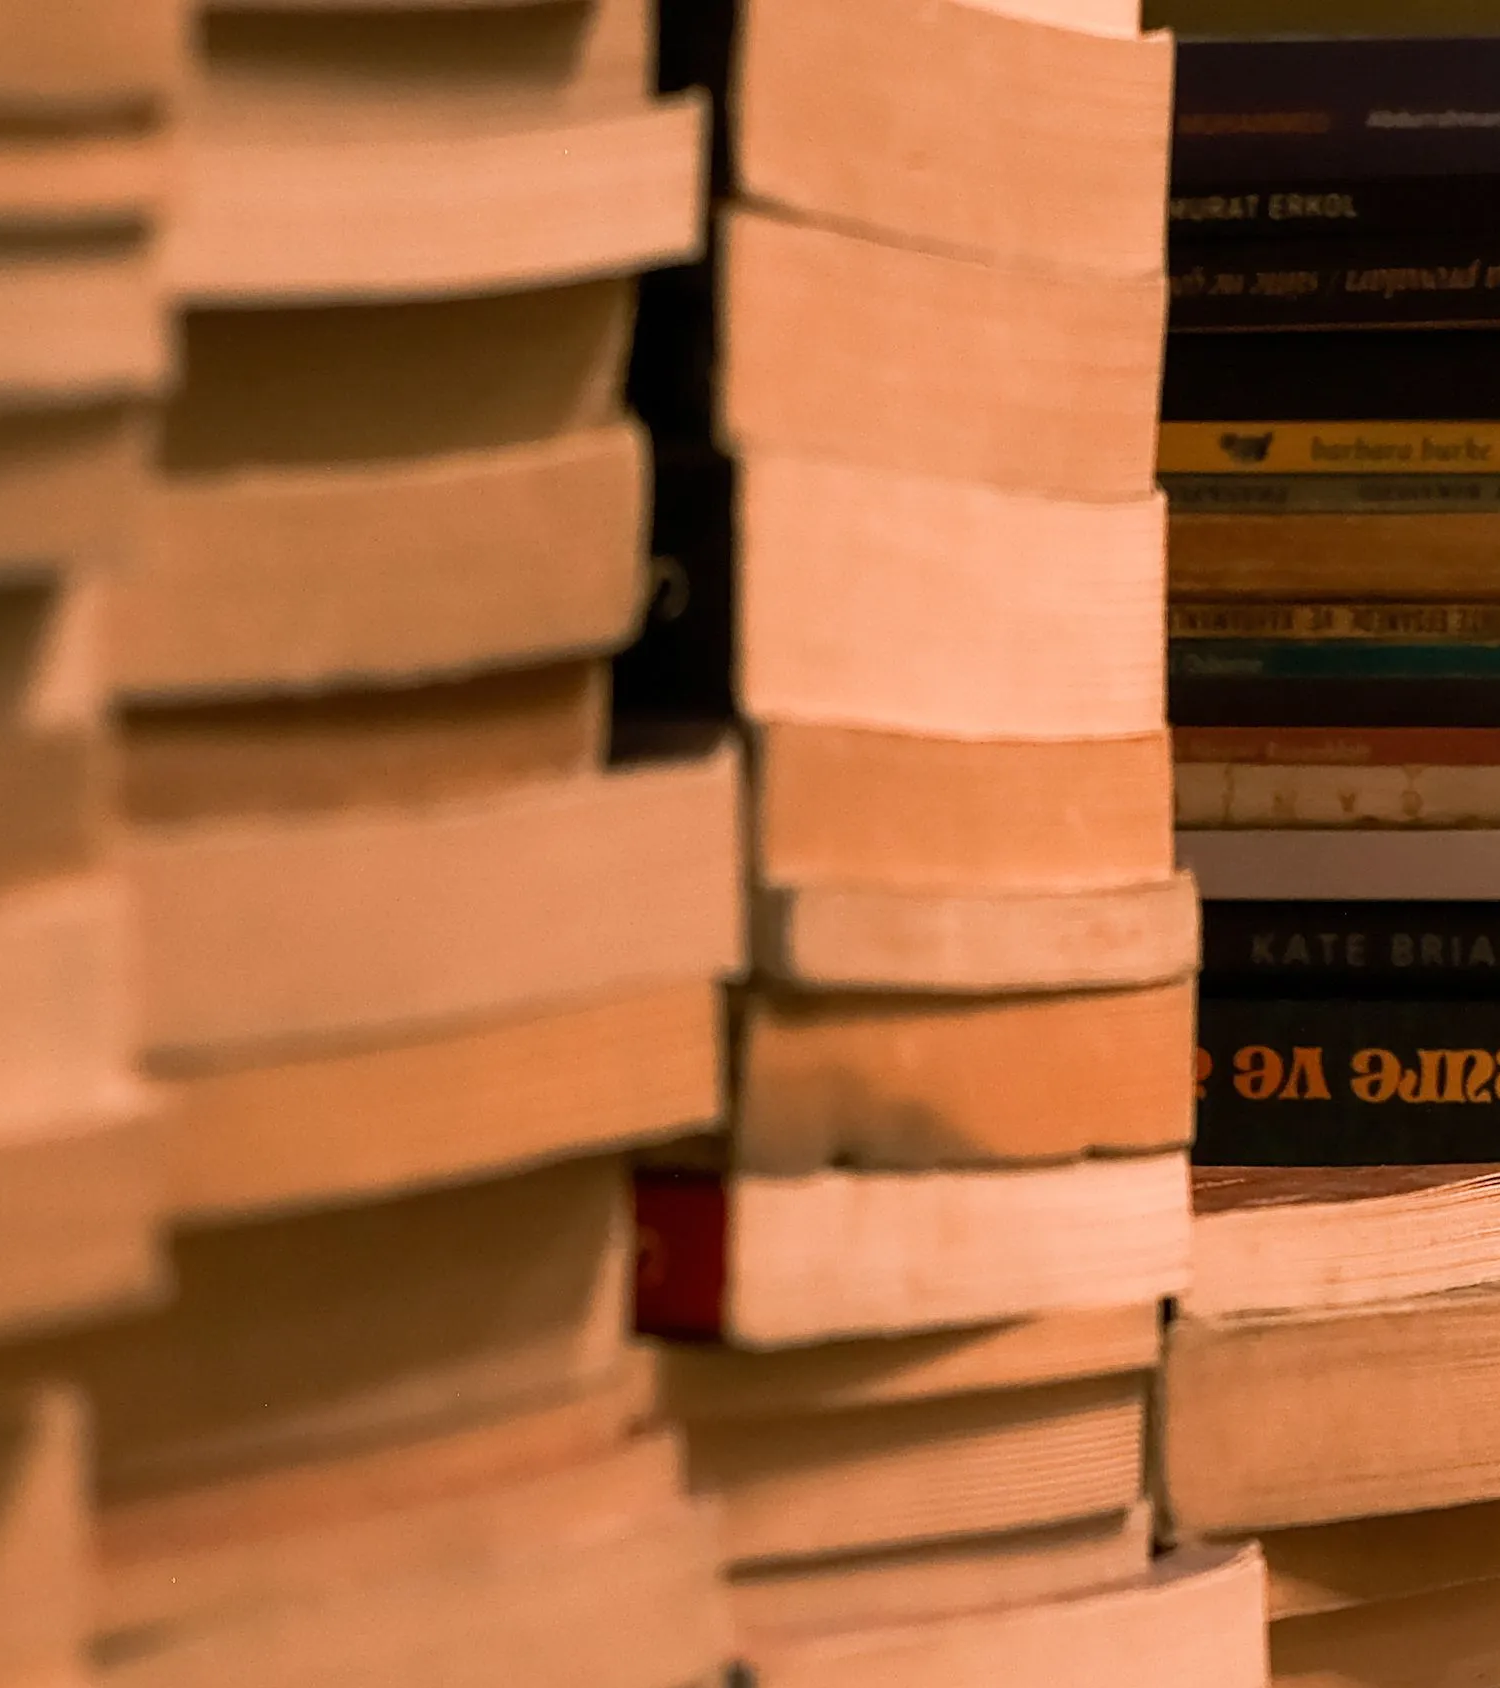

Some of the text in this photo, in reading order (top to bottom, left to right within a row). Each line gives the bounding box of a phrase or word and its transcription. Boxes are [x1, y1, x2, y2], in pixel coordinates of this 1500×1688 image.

[1268, 192, 1358, 220] ERKOL
[1251, 932, 1367, 967] KATE
[1232, 1044, 1332, 1101] ve
